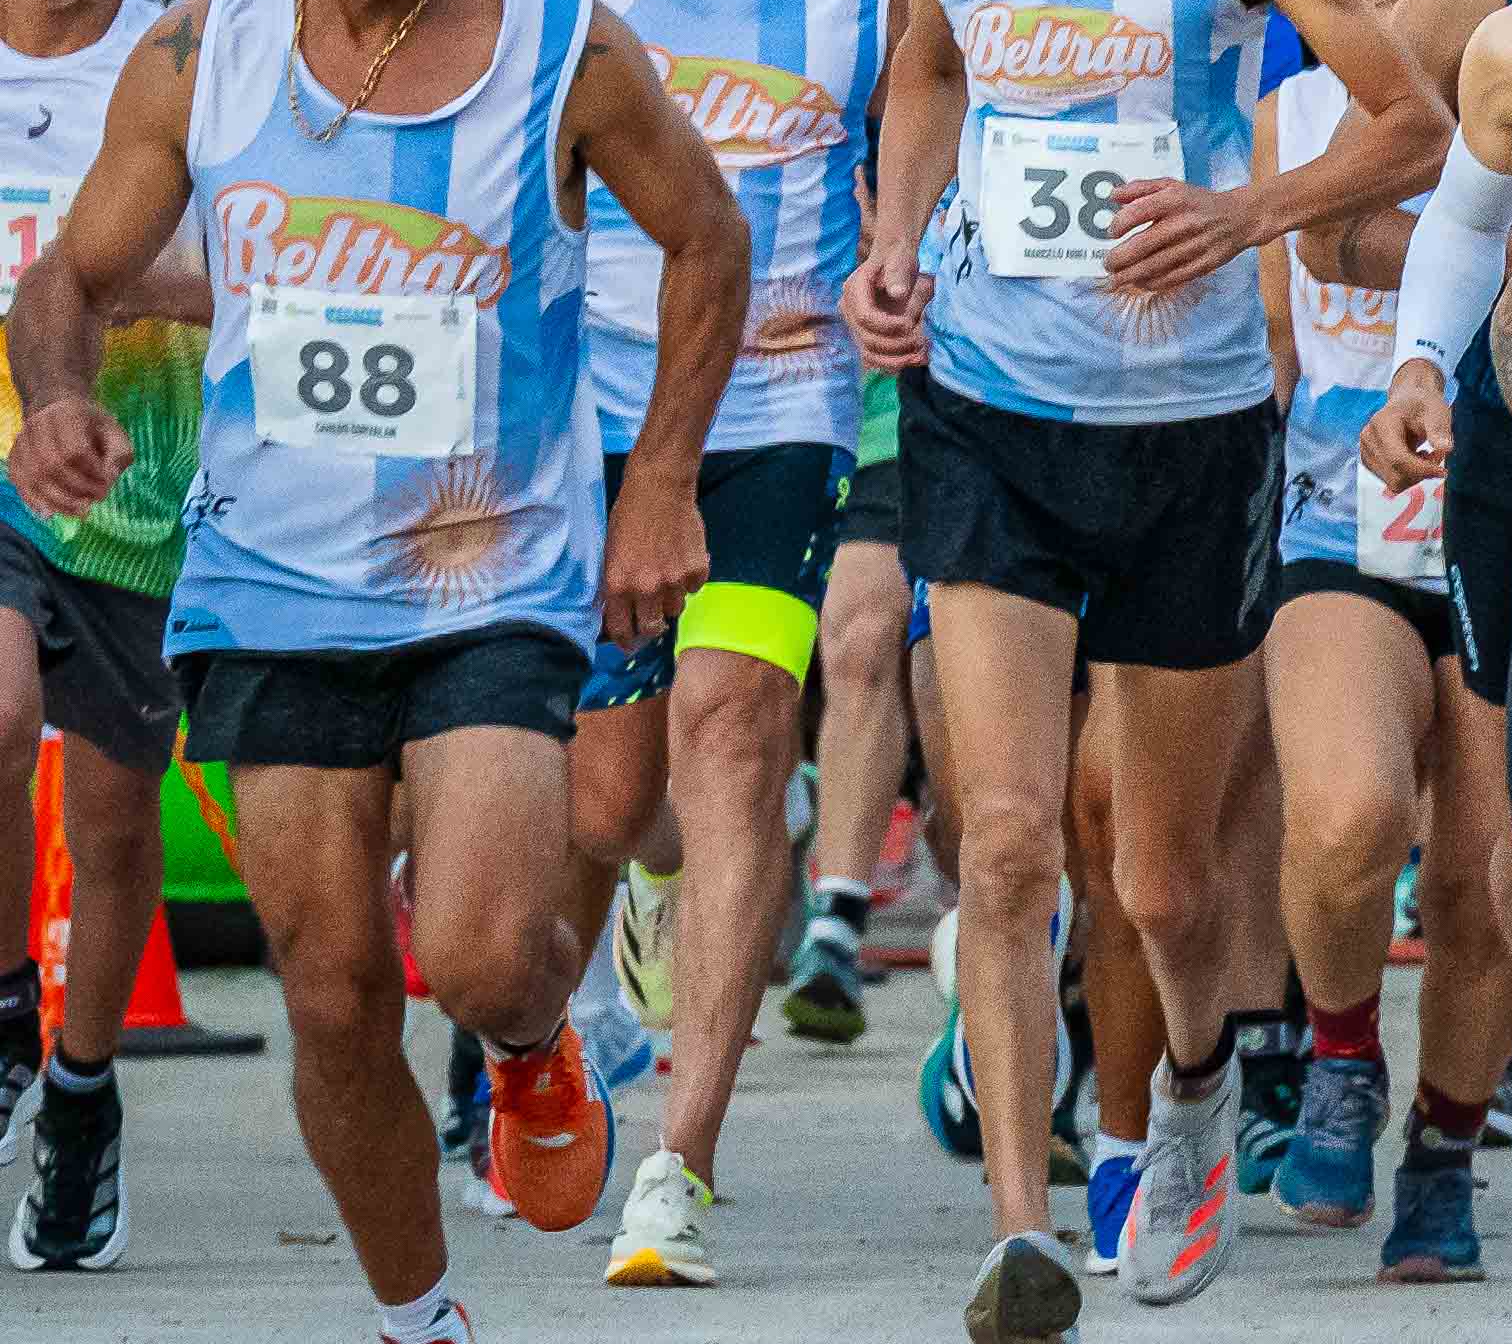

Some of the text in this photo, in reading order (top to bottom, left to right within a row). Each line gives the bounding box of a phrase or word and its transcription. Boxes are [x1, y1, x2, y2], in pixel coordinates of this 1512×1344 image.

[963, 3, 1173, 83] Beltrán
[648, 46, 848, 152] eltrán
[1019, 168, 1126, 240] 38
[298, 340, 417, 416] 88
